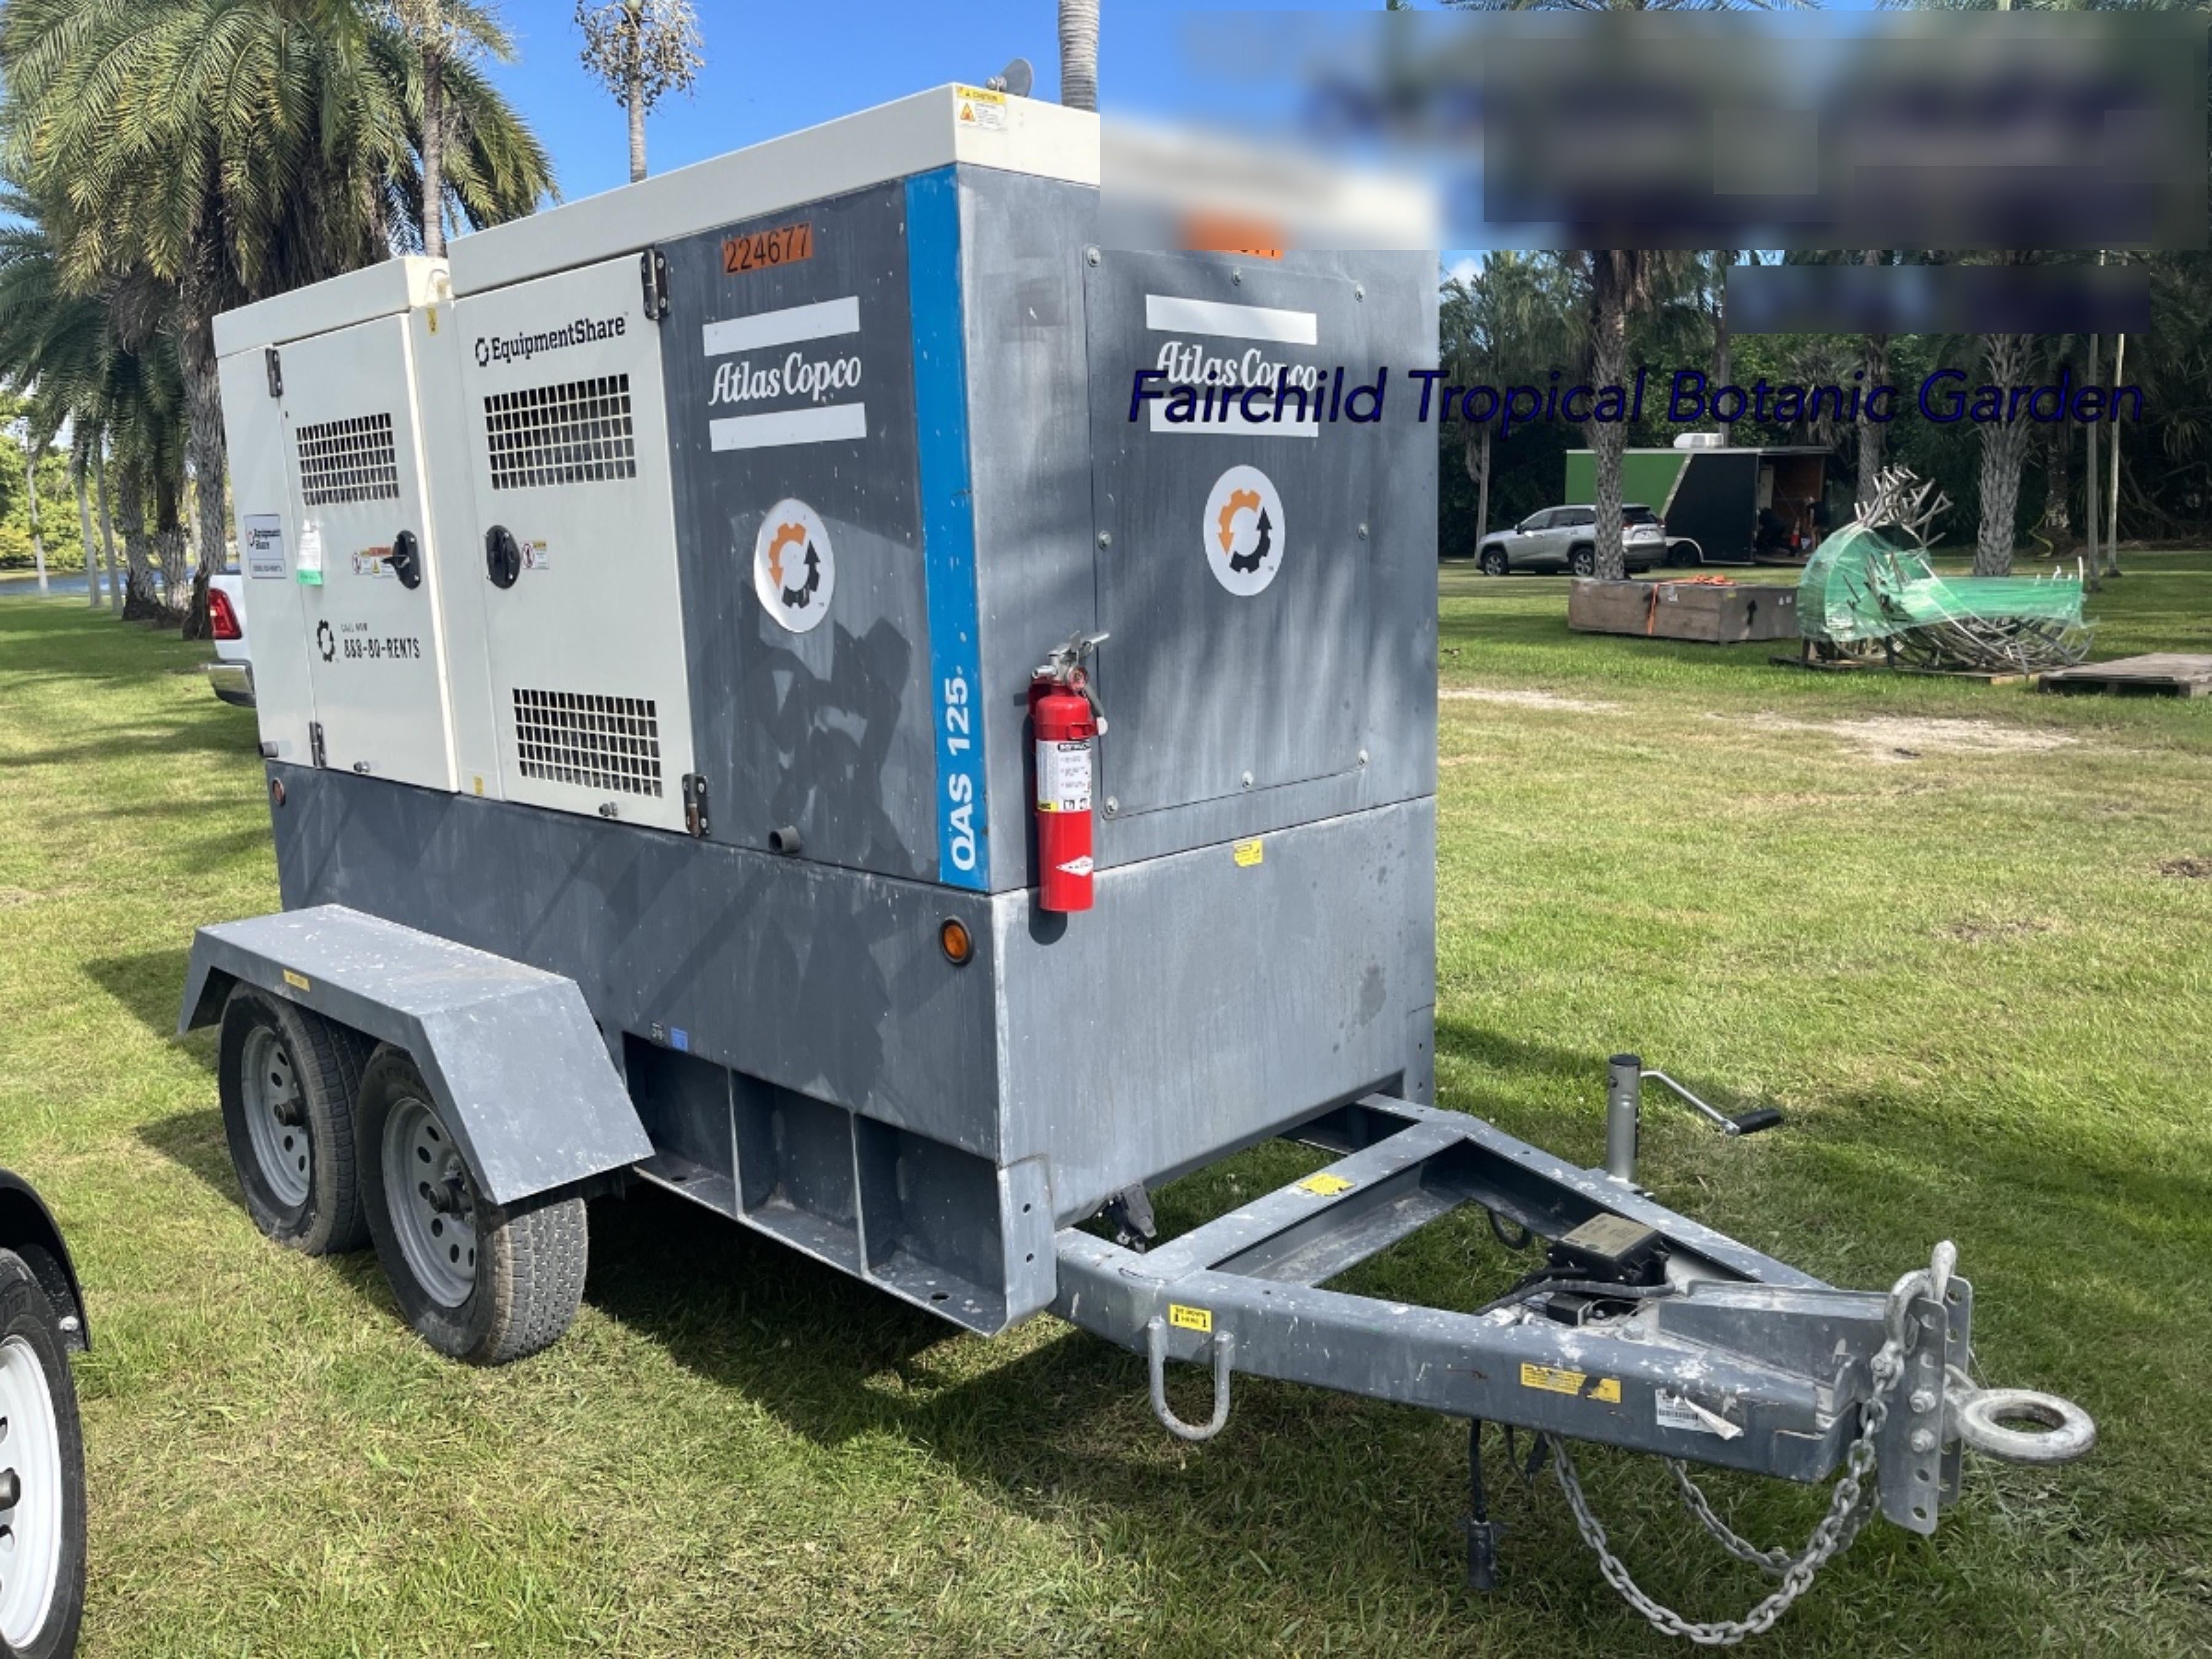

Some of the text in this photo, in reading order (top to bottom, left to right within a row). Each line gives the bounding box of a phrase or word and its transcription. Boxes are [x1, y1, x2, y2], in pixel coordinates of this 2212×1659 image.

[726, 223, 810, 273] 224677
[491, 316, 625, 364] EquipmentShare
[1148, 341, 1237, 386] Atlas
[708, 351, 861, 406] Atlas Copco
[944, 677, 970, 756] 125
